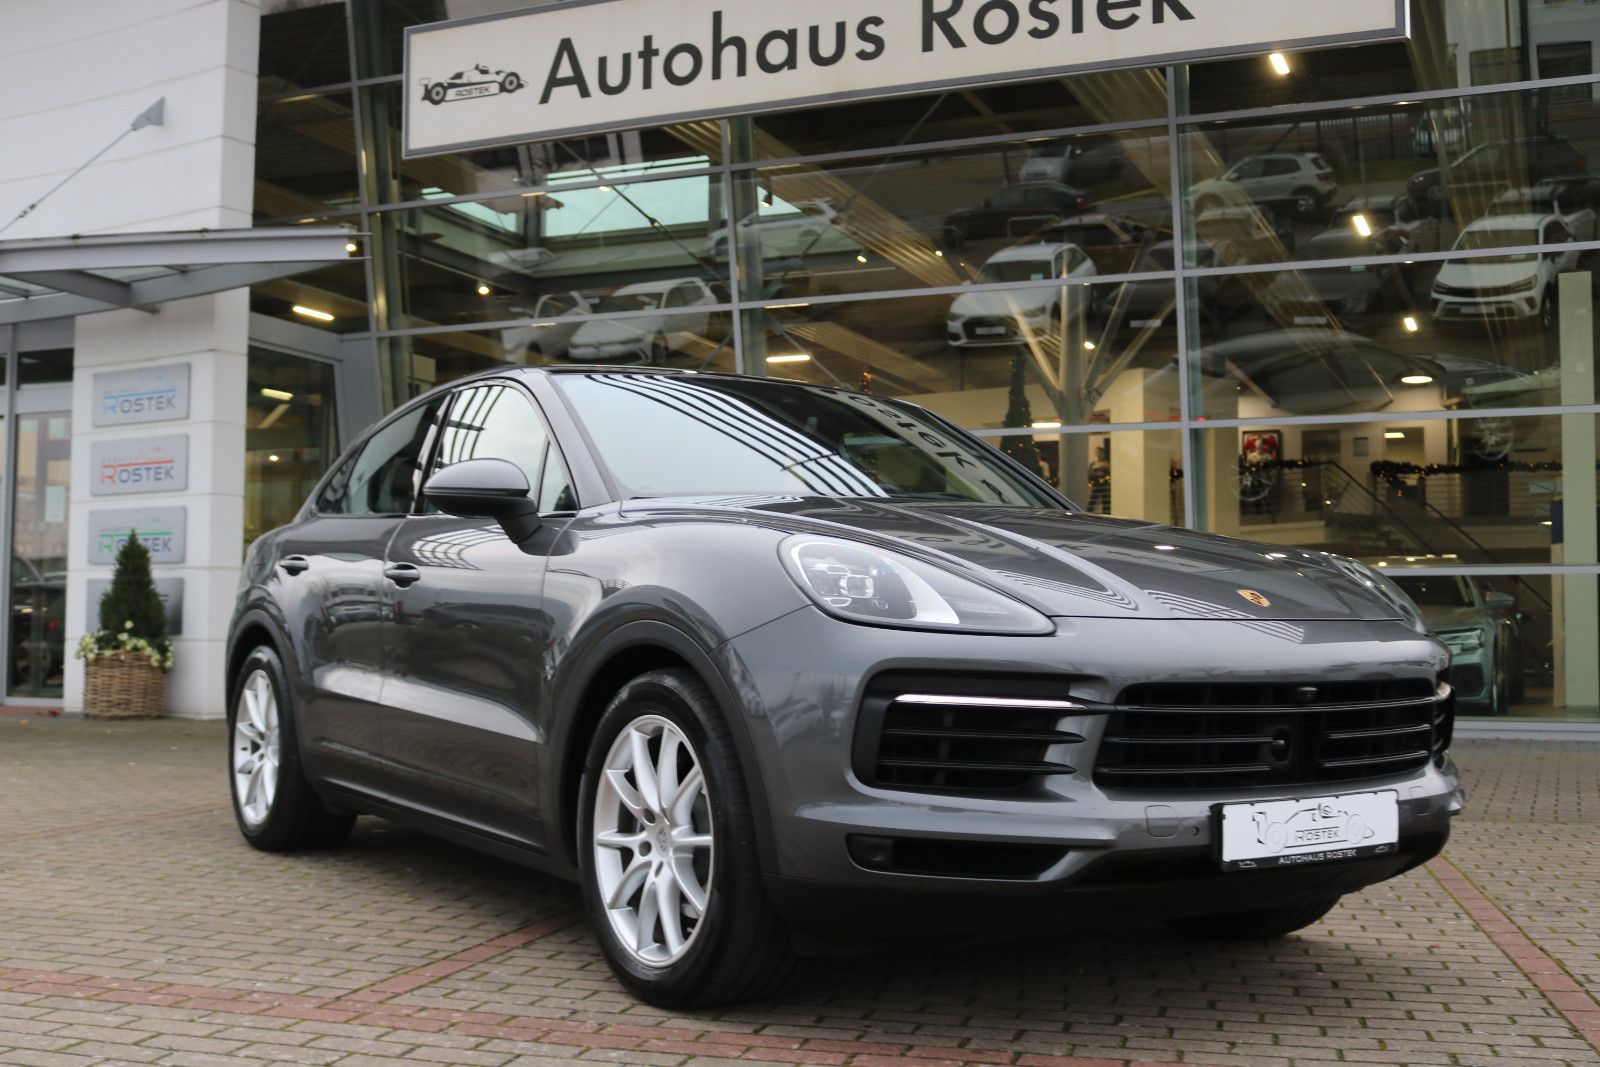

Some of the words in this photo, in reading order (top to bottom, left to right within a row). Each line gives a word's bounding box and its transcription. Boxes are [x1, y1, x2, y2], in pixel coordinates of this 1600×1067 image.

[538, 11, 885, 105] Autohaus
[103, 391, 176, 415] ROSTEK
[101, 461, 174, 484] ROSTEK
[98, 533, 172, 553] ROTEK
[1295, 828, 1340, 842] ROSTEK
[1278, 851, 1325, 865] AUTOHAUS
[1326, 848, 1357, 860] ROSTEK
